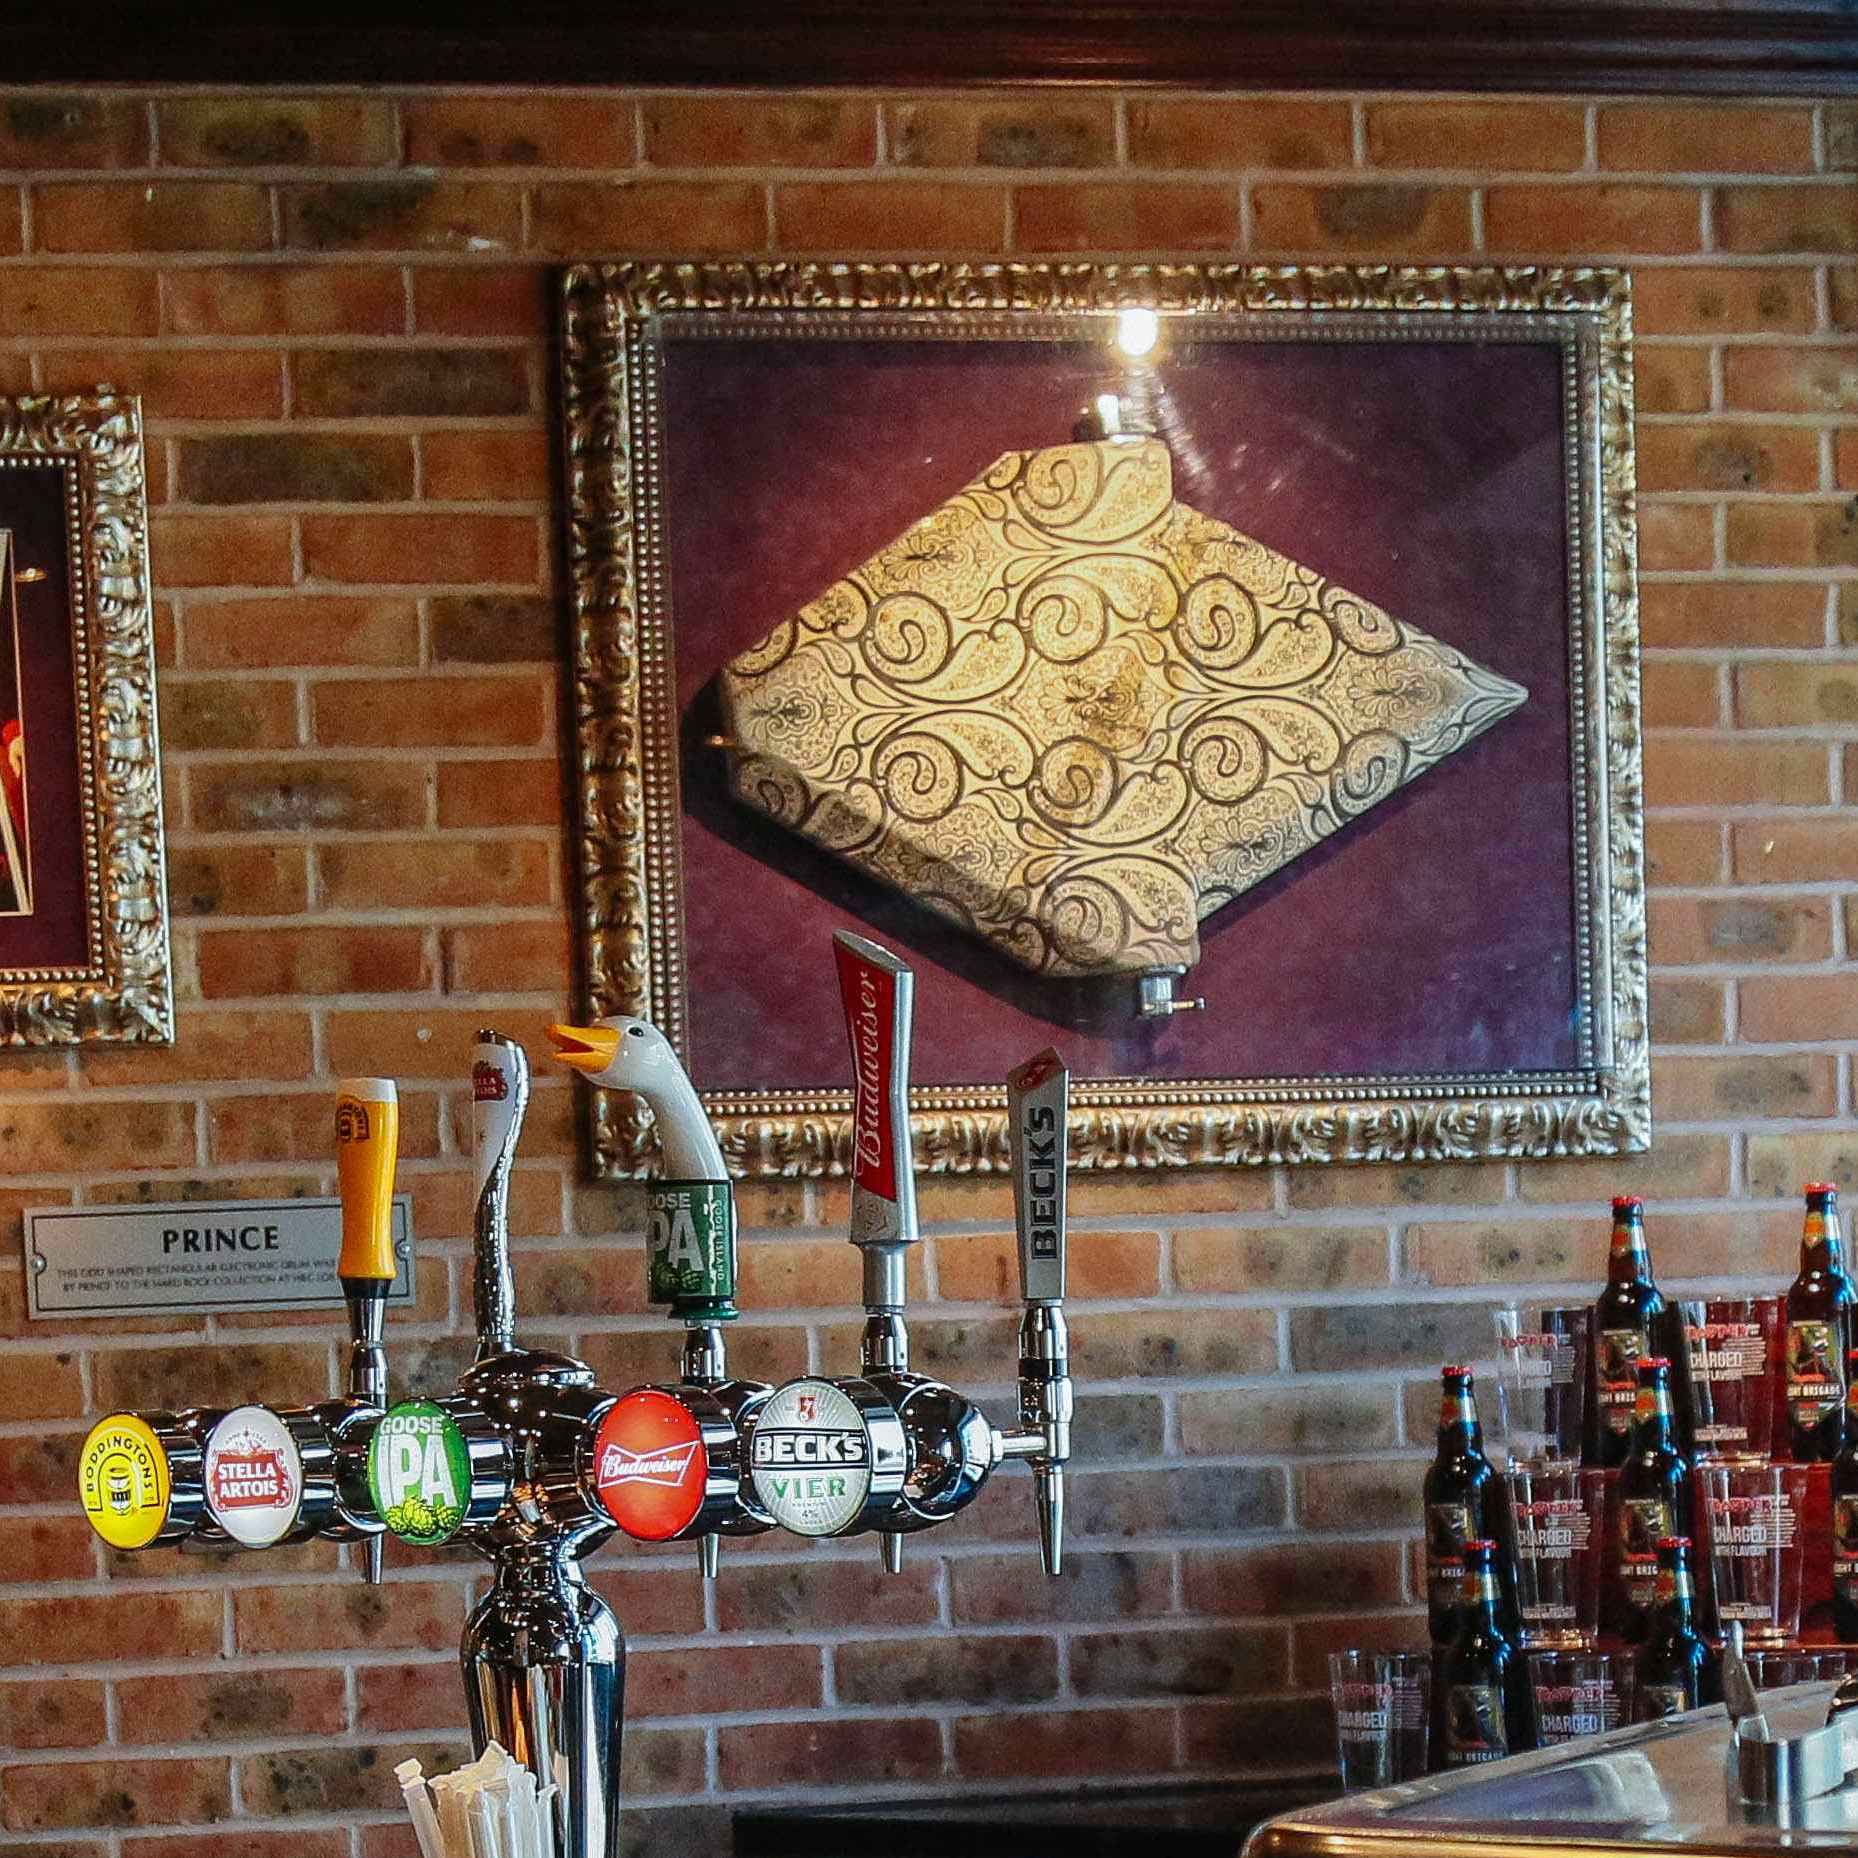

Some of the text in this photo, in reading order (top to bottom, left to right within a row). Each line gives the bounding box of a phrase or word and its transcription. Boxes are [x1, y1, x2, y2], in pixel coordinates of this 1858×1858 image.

[854, 969, 882, 1178] Budweiser
[1023, 1106, 1057, 1260] BECK'S
[646, 1192, 691, 1210] OOSE
[162, 1225, 280, 1254] PRINCE
[647, 1209, 704, 1272] PA
[1690, 1351, 1743, 1369] CHARGED
[1803, 1383, 1841, 1396] BRIGADE
[379, 1414, 443, 1436] GOOSE
[755, 1432, 863, 1463] BECK'S
[86, 1435, 152, 1492] BODDINGTONS
[218, 1463, 276, 1479] STELLA
[375, 1434, 458, 1508] IPA
[602, 1453, 689, 1478] Budweiser
[220, 1480, 278, 1498] ARTOIS
[768, 1476, 846, 1499] VIER
[1517, 1528, 1572, 1546] CHARGED
[1713, 1525, 1767, 1543] CHARGED
[1542, 1713, 1598, 1734] CHARGED
